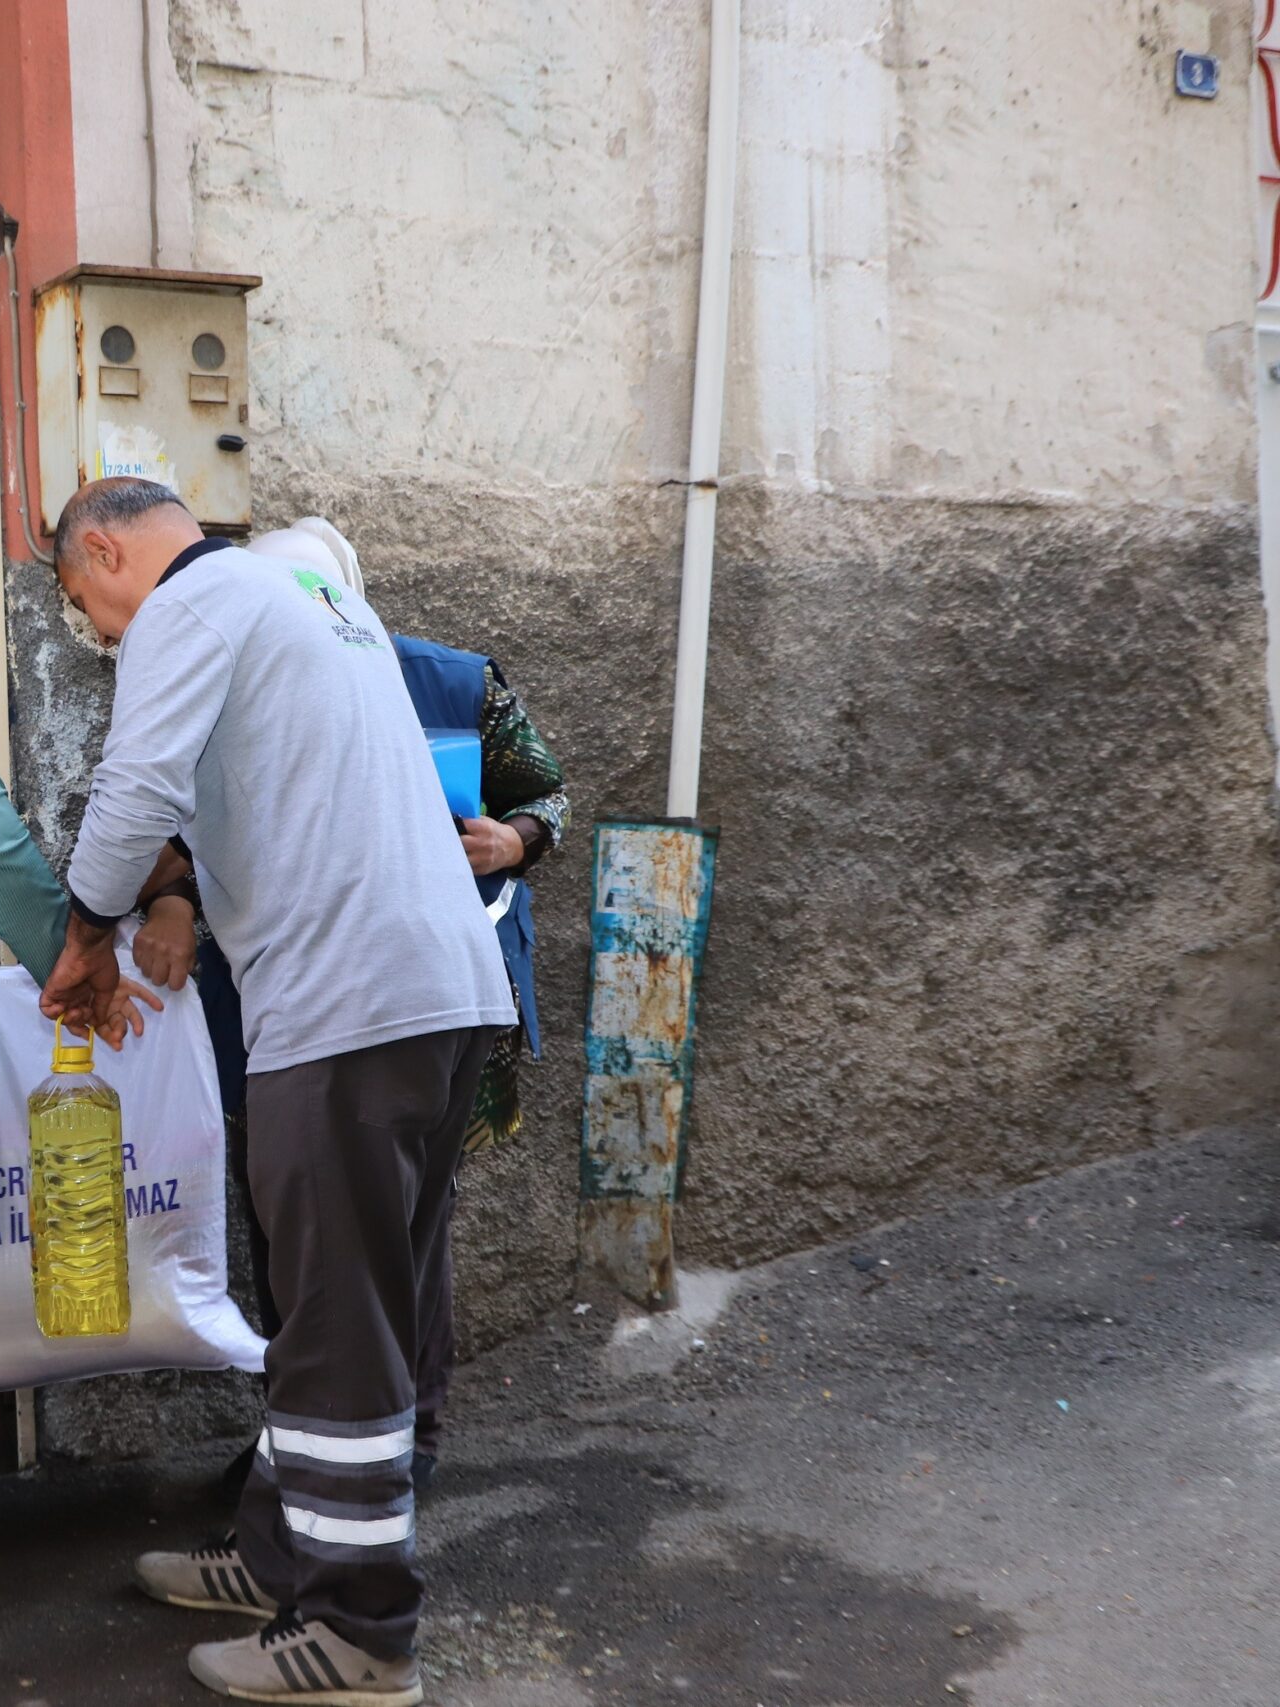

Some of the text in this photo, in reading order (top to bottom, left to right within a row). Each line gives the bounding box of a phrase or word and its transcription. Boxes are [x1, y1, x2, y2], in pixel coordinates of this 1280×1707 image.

[106, 464, 130, 475] 7/24
[10, 1206, 29, 1244] İL
[123, 1179, 180, 1219] MAZ
